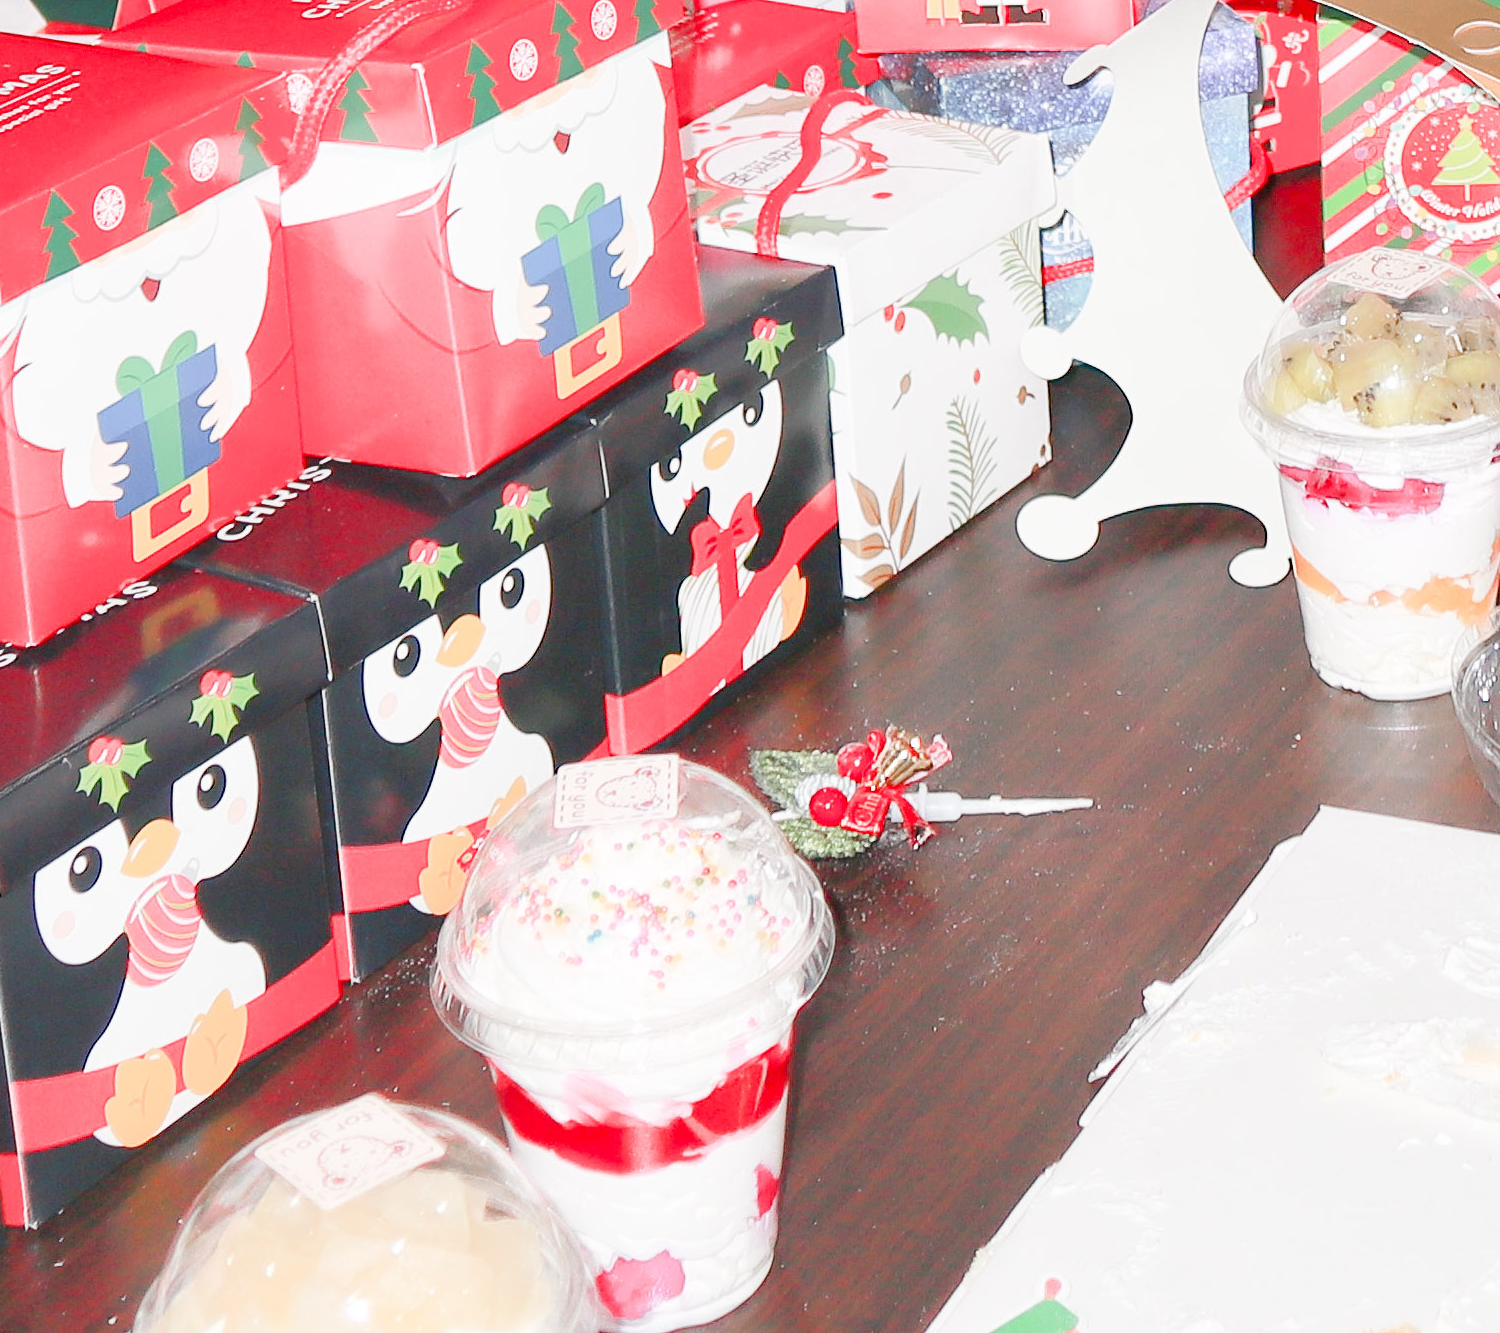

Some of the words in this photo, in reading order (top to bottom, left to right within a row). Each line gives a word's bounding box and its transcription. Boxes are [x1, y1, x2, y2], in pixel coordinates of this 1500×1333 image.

[719, 141, 803, 188] 圣诞快
[1421, 189, 1461, 217] Winter
